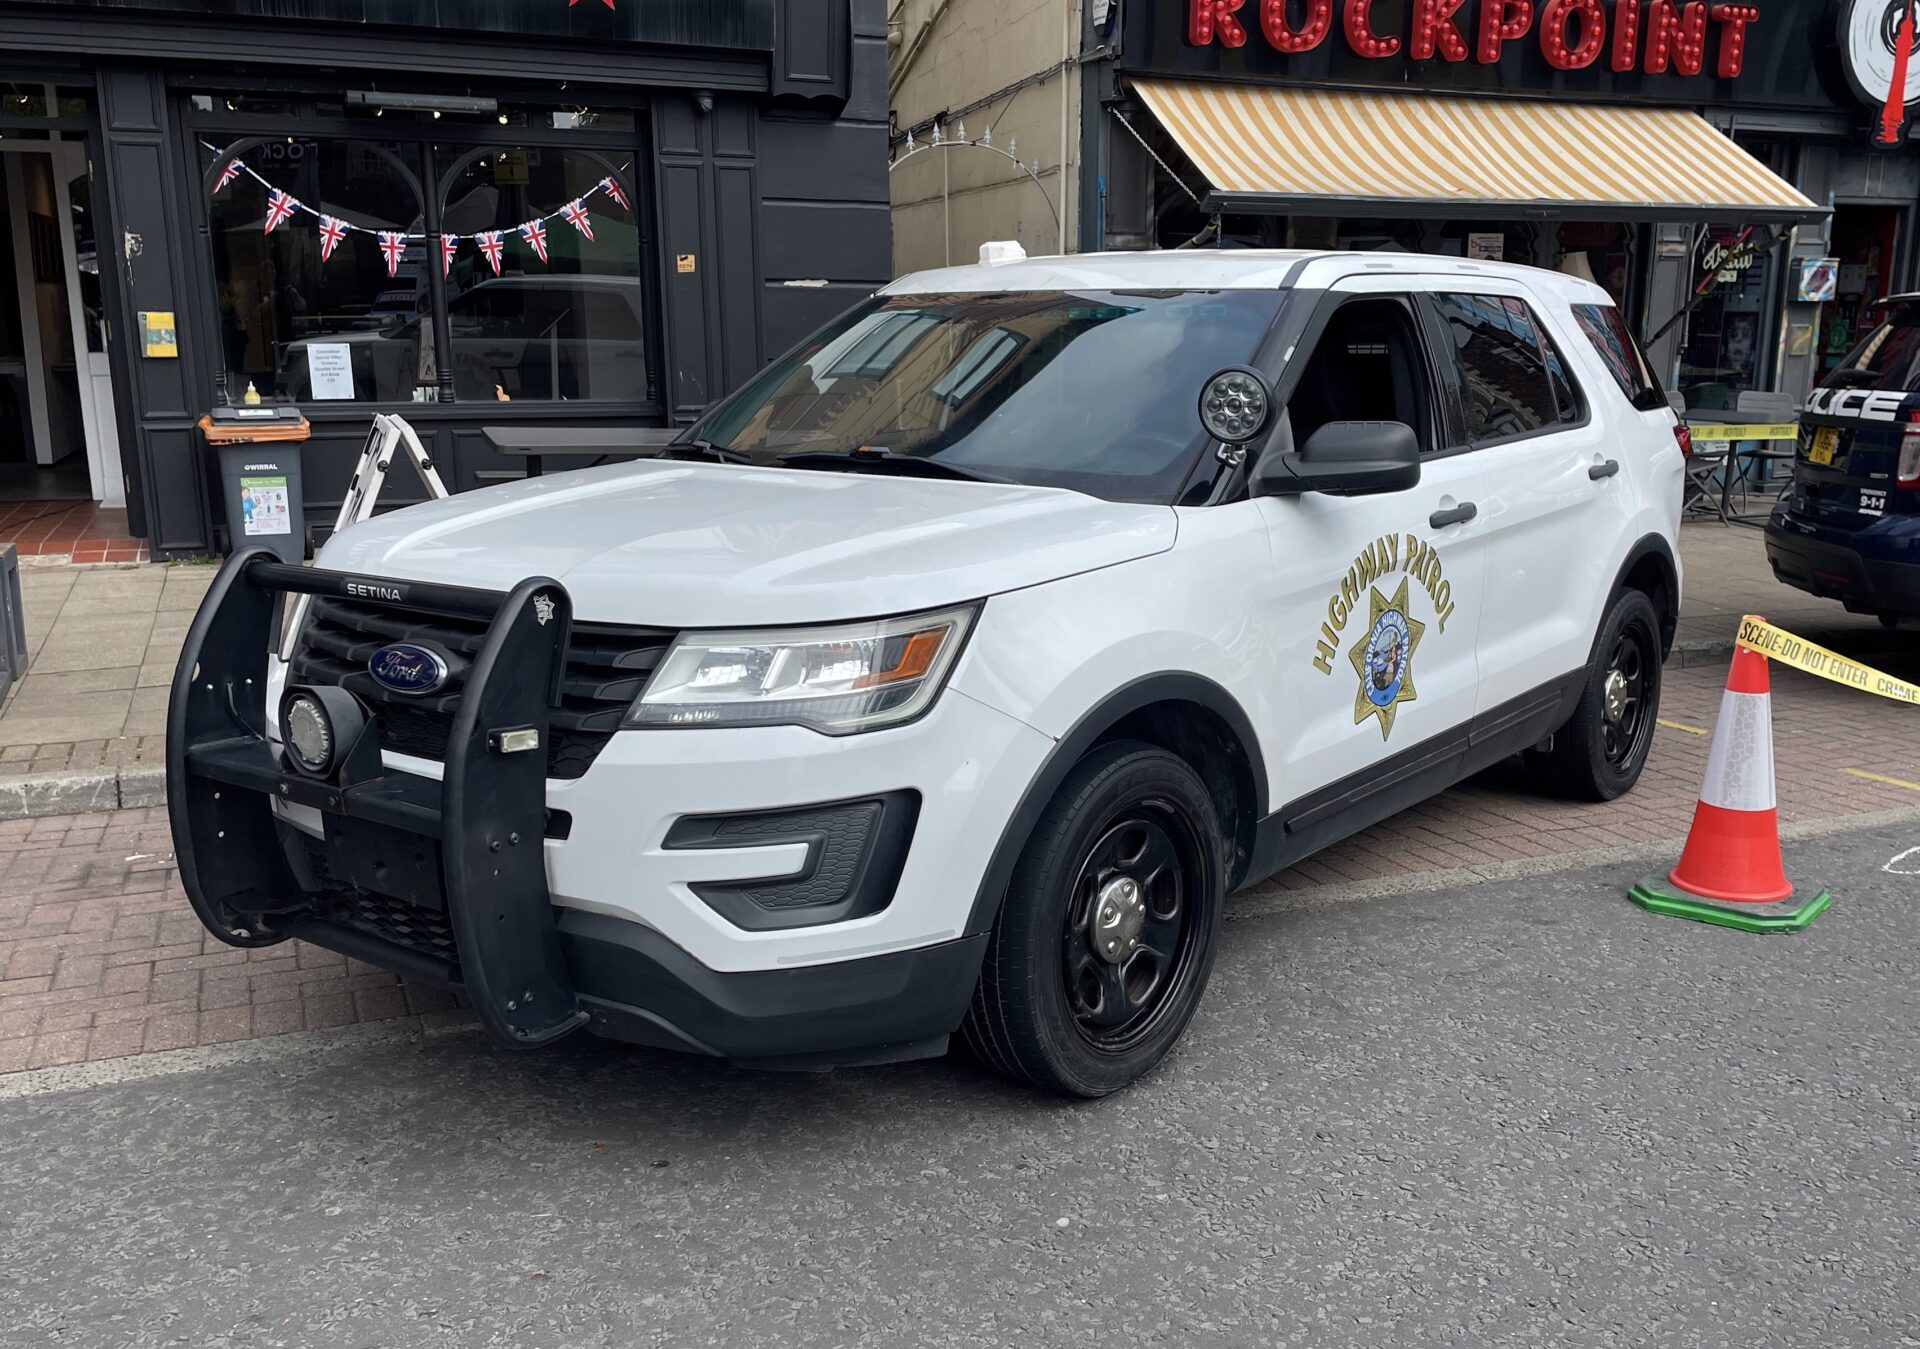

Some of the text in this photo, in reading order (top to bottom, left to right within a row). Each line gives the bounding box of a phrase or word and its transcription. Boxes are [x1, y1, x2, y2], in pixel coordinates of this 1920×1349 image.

[1189, 0, 1759, 78] ROCKPOINT
[1804, 388, 1908, 421] OLICE
[346, 583, 402, 601] SETINA
[1313, 533, 1455, 676] HIGHWAY PATROL
[376, 651, 423, 681] Ford
[1365, 623, 1383, 696] CALIFORNIA
[1739, 622, 1920, 702] SCENE-DO NOT ENTER CRIME
